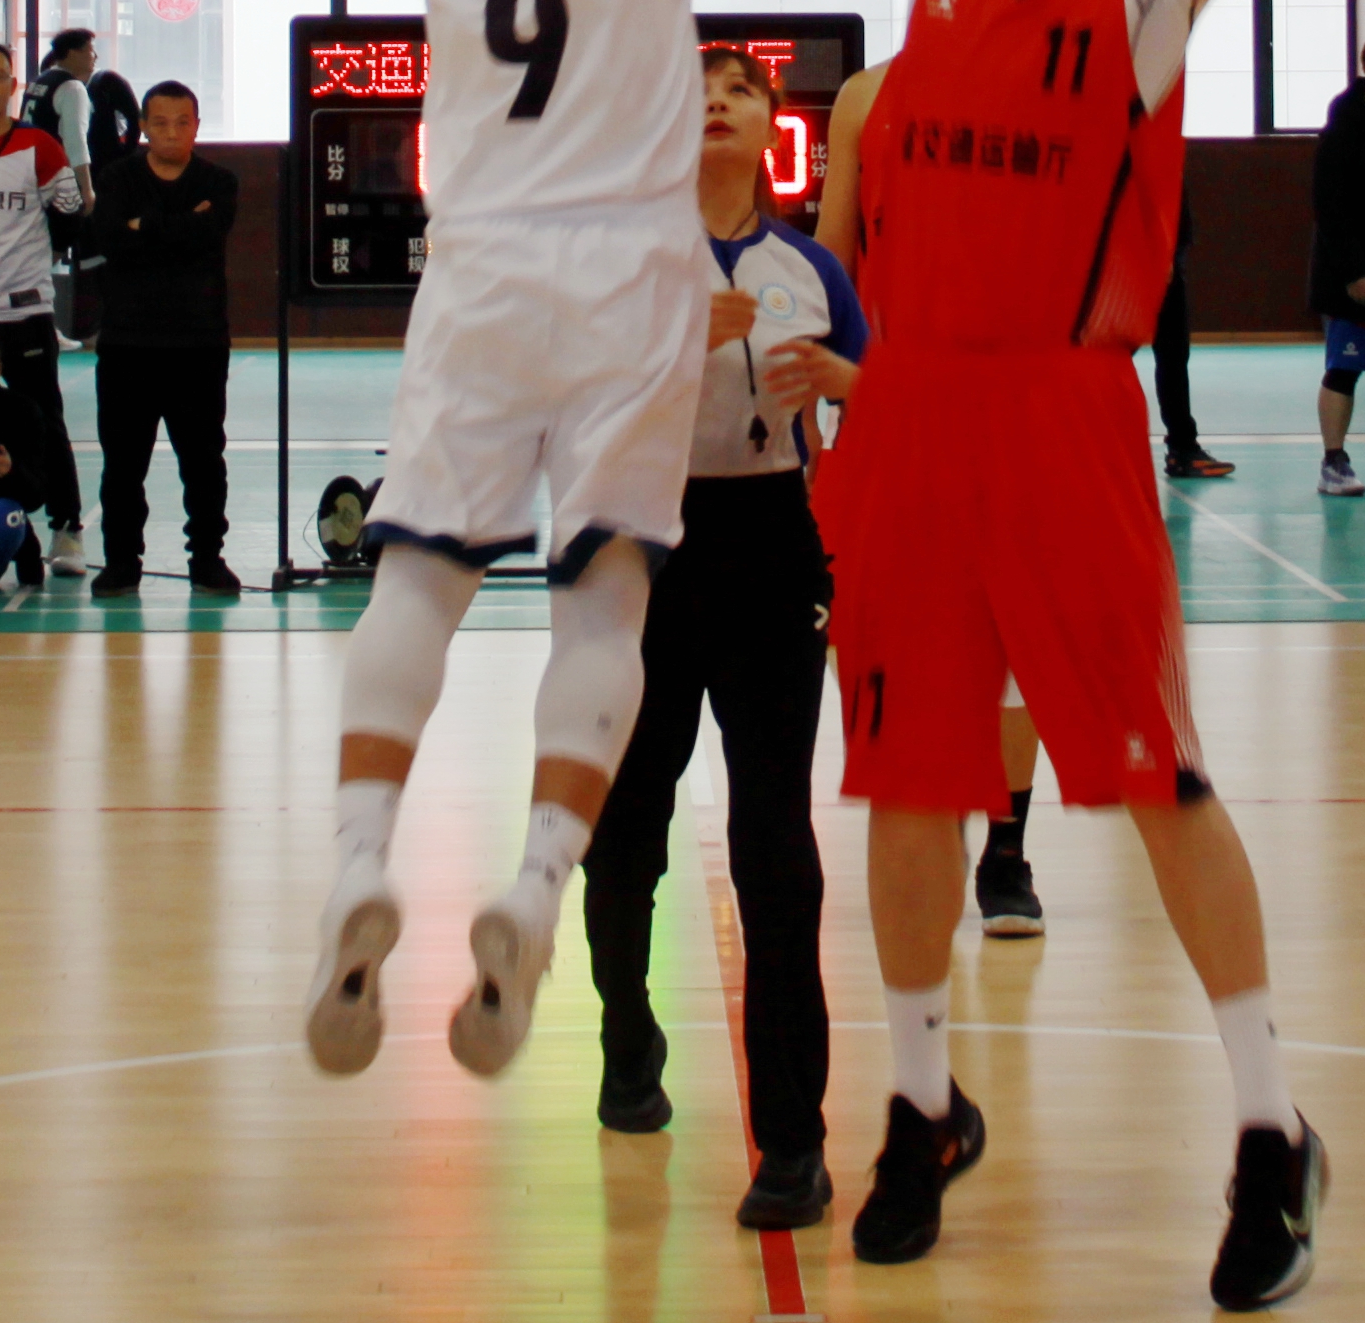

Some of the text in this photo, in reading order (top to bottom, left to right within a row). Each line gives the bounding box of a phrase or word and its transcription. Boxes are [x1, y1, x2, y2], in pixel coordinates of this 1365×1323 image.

[310, 42, 431, 96] 交通
[1042, 20, 1092, 94] 11
[327, 144, 345, 181] 比分
[332, 238, 350, 274] 球权
